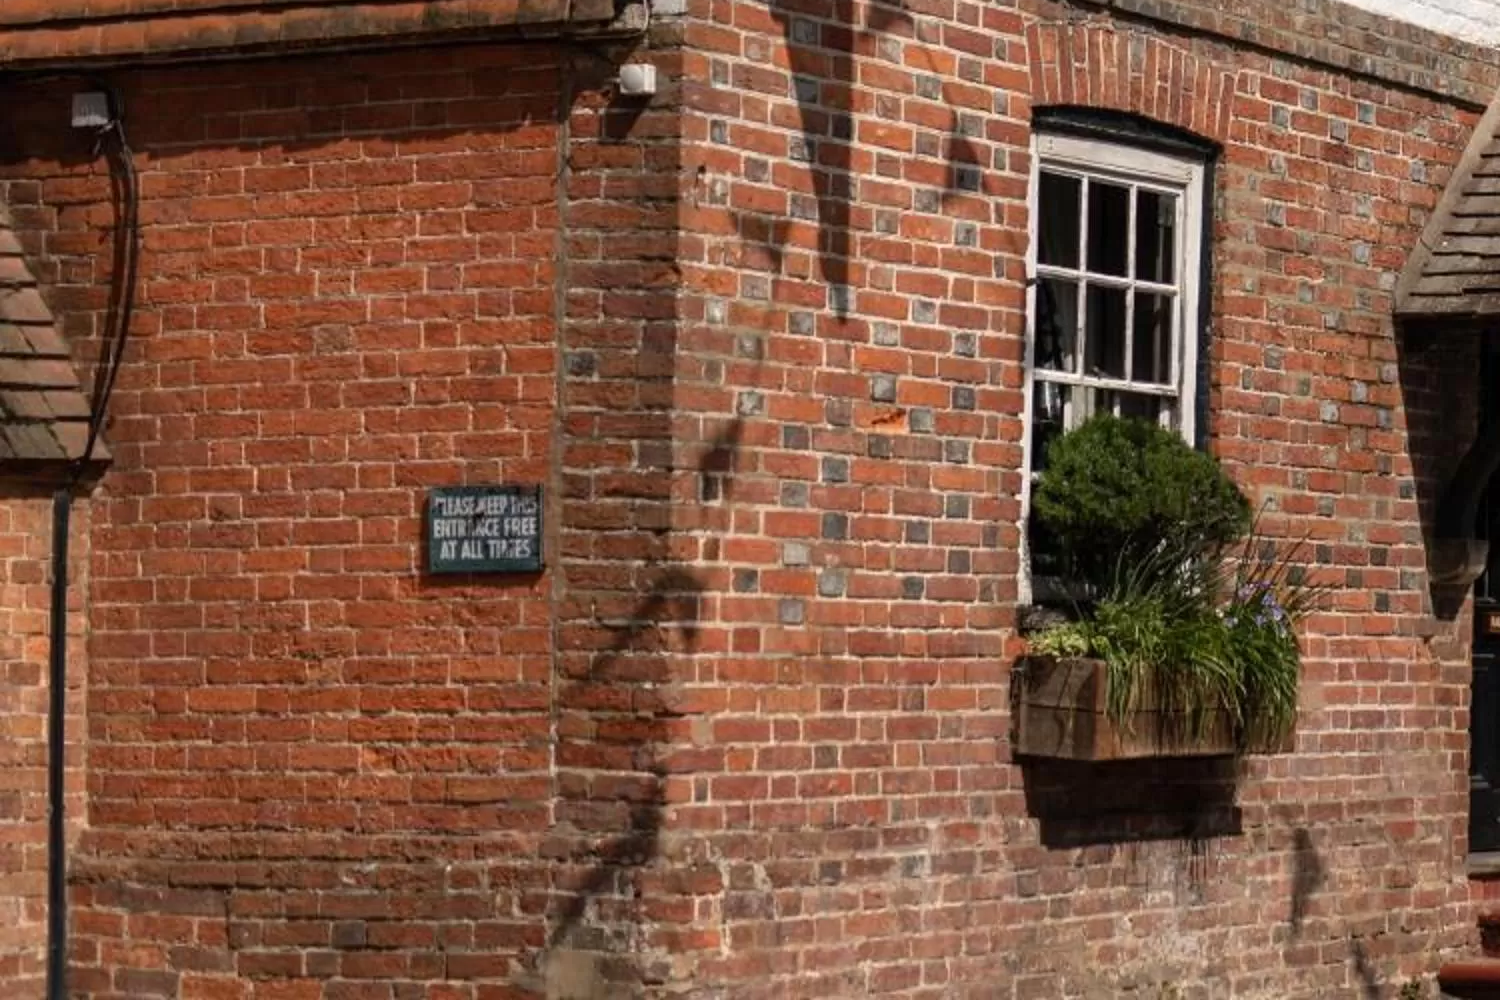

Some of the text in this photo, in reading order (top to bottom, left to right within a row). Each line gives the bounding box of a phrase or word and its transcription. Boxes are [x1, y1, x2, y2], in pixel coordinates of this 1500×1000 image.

[502, 517, 538, 537] FREE
[440, 540, 458, 560] AT
[460, 539, 485, 560] ALL
